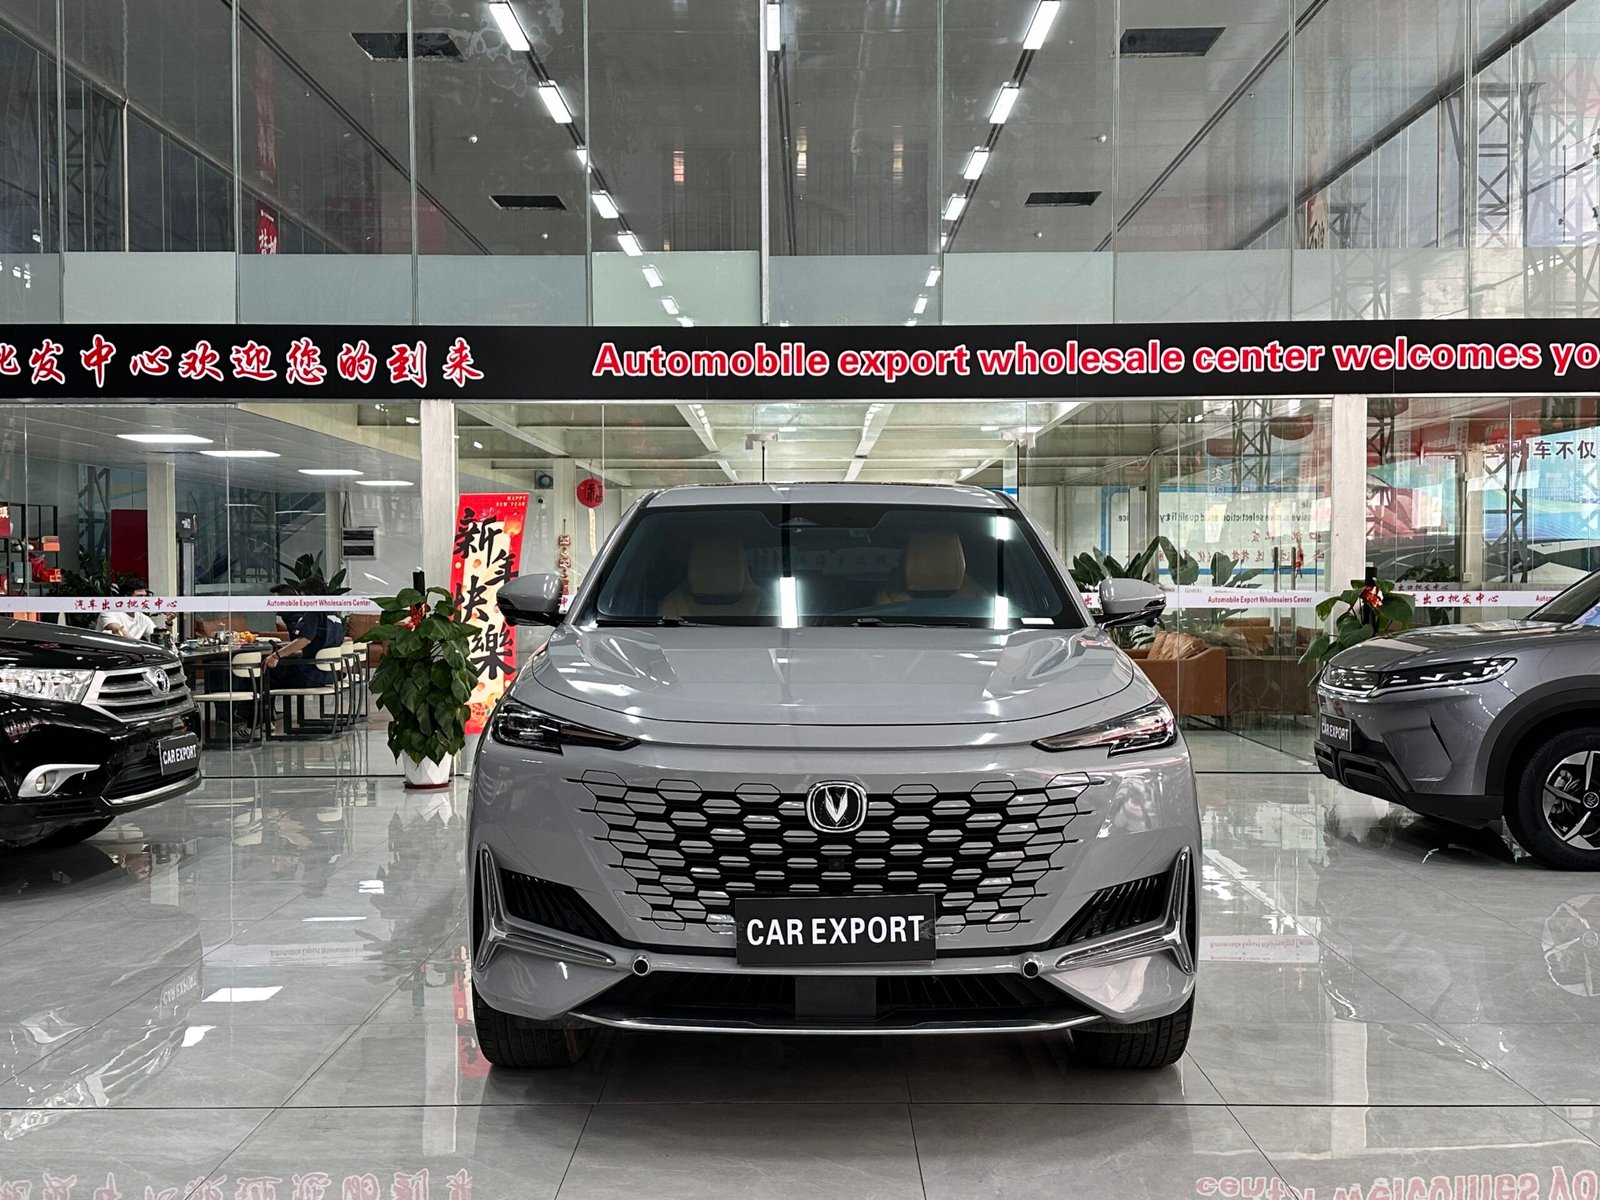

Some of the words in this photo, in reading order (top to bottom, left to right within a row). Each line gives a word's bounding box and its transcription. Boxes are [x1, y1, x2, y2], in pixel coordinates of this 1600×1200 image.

[592, 342, 829, 376] Automobile
[837, 343, 970, 383] export
[977, 339, 1185, 375] wholesale
[1192, 340, 1325, 374] center
[1333, 336, 1542, 371] welcomes
[1548, 342, 1600, 376] yo
[74, 597, 178, 611] 汽车出口批发中心
[266, 599, 299, 607] Automobile
[300, 599, 318, 608] Export
[319, 599, 351, 607] Wholesalers
[352, 598, 371, 607] Center
[1207, 595, 1240, 603] Automobile
[1240, 595, 1259, 604] Export
[1260, 595, 1293, 603] Wholesalers
[1293, 595, 1312, 603] Center
[162, 749, 176, 765] CAR
[175, 744, 197, 762] EXPORT
[746, 918, 804, 946] CAR
[811, 914, 925, 945] EXPORT
